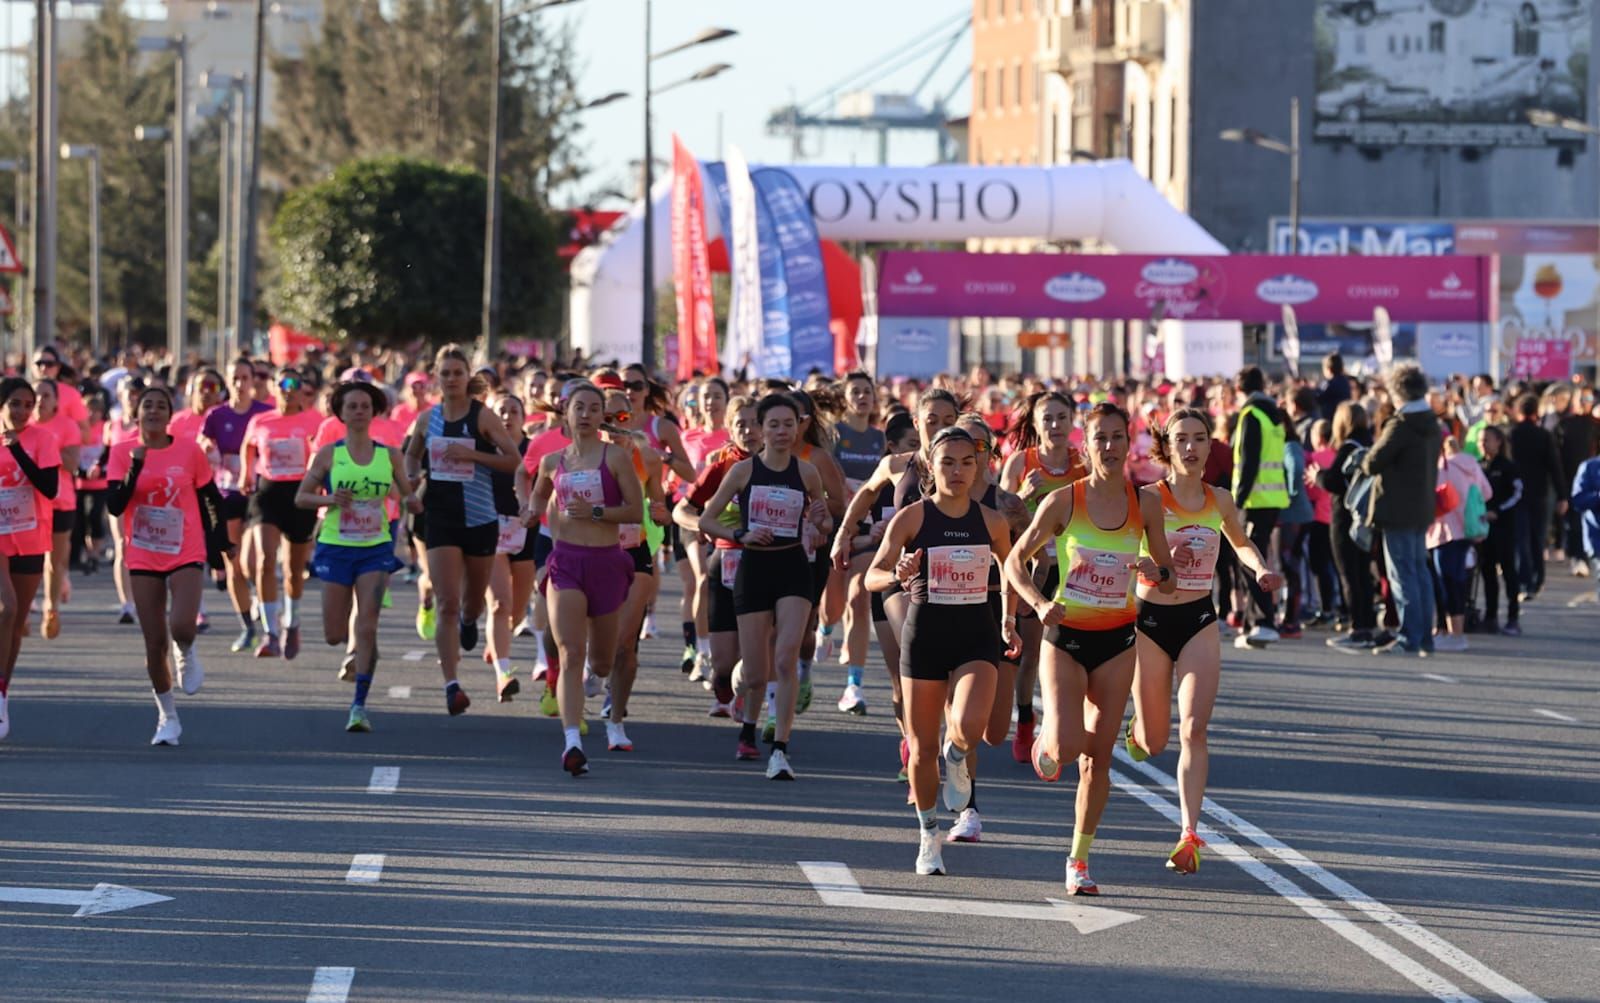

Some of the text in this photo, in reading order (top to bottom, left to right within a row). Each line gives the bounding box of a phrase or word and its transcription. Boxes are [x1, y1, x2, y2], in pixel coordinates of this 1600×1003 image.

[809, 178, 1020, 223] OYSHO
[1277, 227, 1454, 256] Del Mar
[767, 507, 787, 518] 016
[147, 526, 167, 537] 016
[951, 571, 975, 582] 016
[1090, 574, 1115, 586] 016
